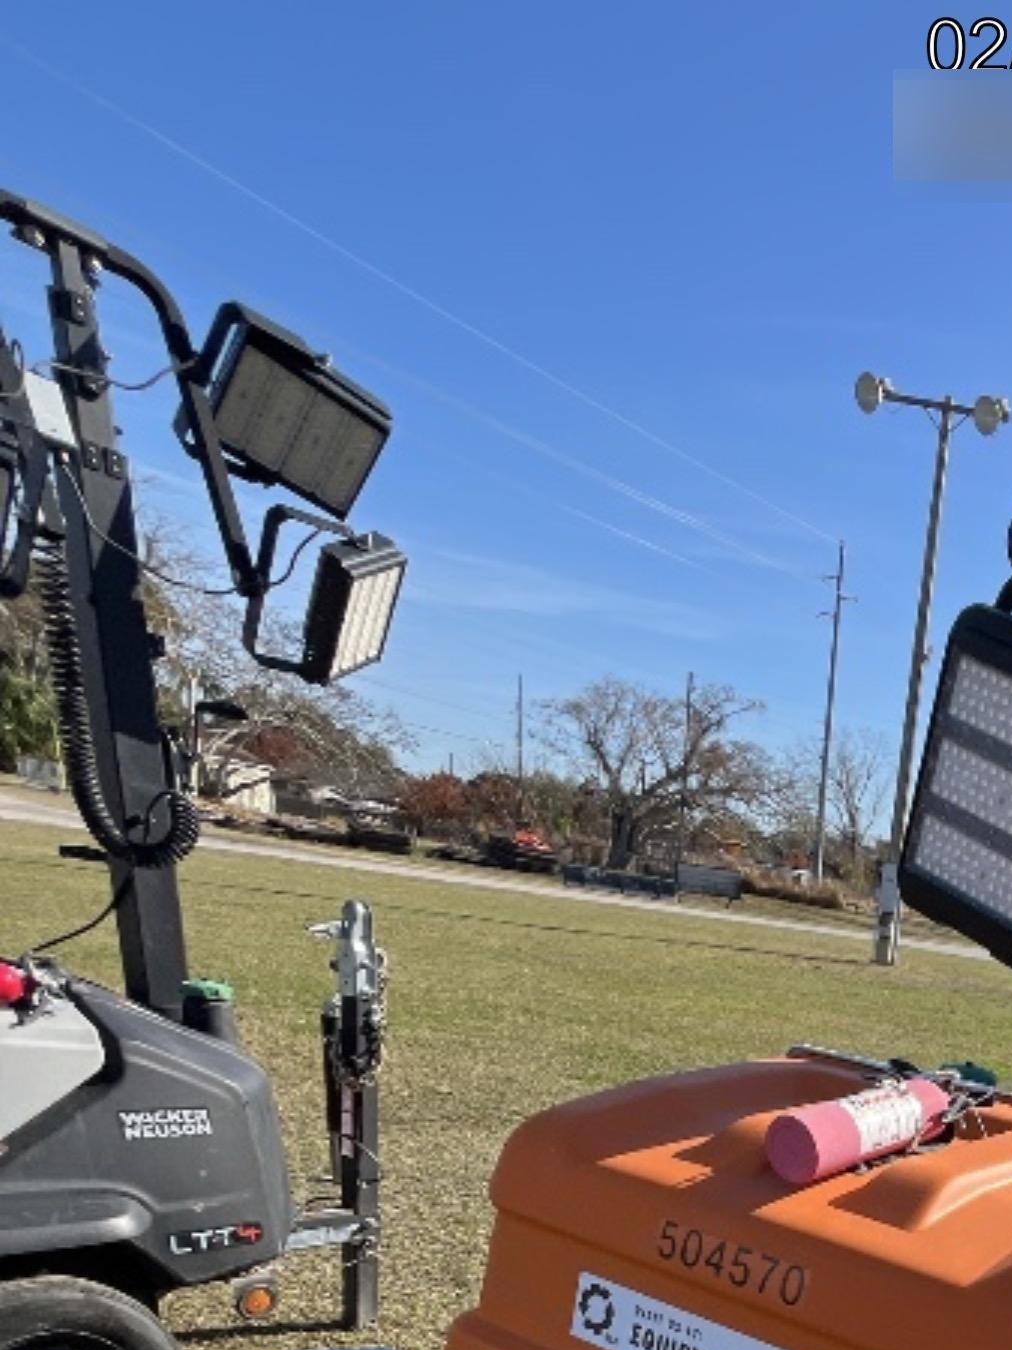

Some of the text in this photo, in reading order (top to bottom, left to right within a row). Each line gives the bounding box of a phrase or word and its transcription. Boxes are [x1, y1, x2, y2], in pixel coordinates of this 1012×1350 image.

[118, 1109, 208, 1126] WACKER
[124, 1120, 213, 1141] NEUSON
[656, 1219, 807, 1306] 504570
